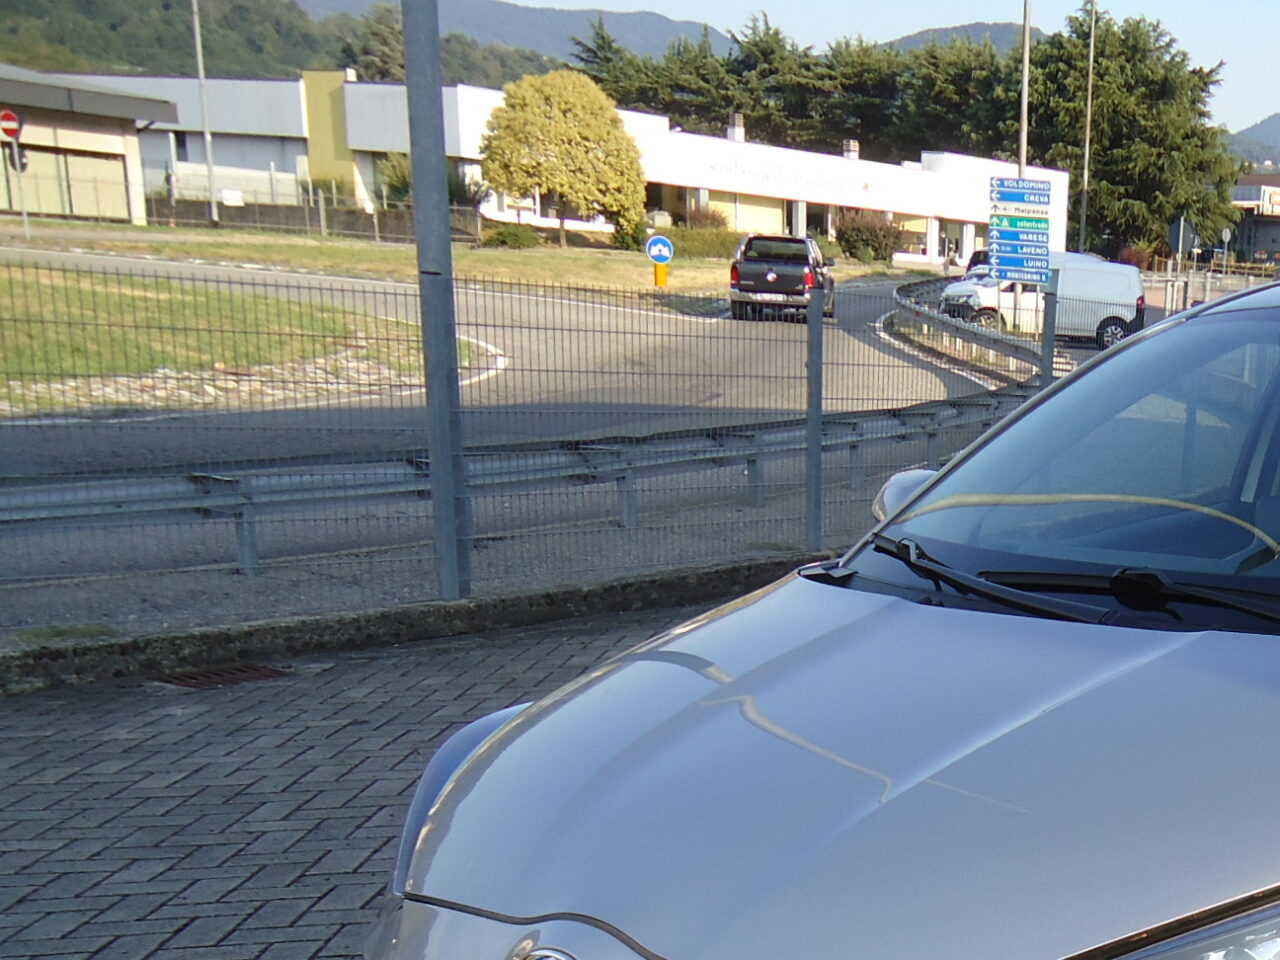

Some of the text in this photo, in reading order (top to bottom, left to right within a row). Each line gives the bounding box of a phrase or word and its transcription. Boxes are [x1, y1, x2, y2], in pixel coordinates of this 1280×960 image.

[1004, 180, 1050, 190] VOLDOMINO
[1024, 194, 1049, 202] CREVA
[1019, 233, 1048, 242] VARESE
[1017, 246, 1048, 255] LAVENO
[1024, 259, 1048, 268] LUINO
